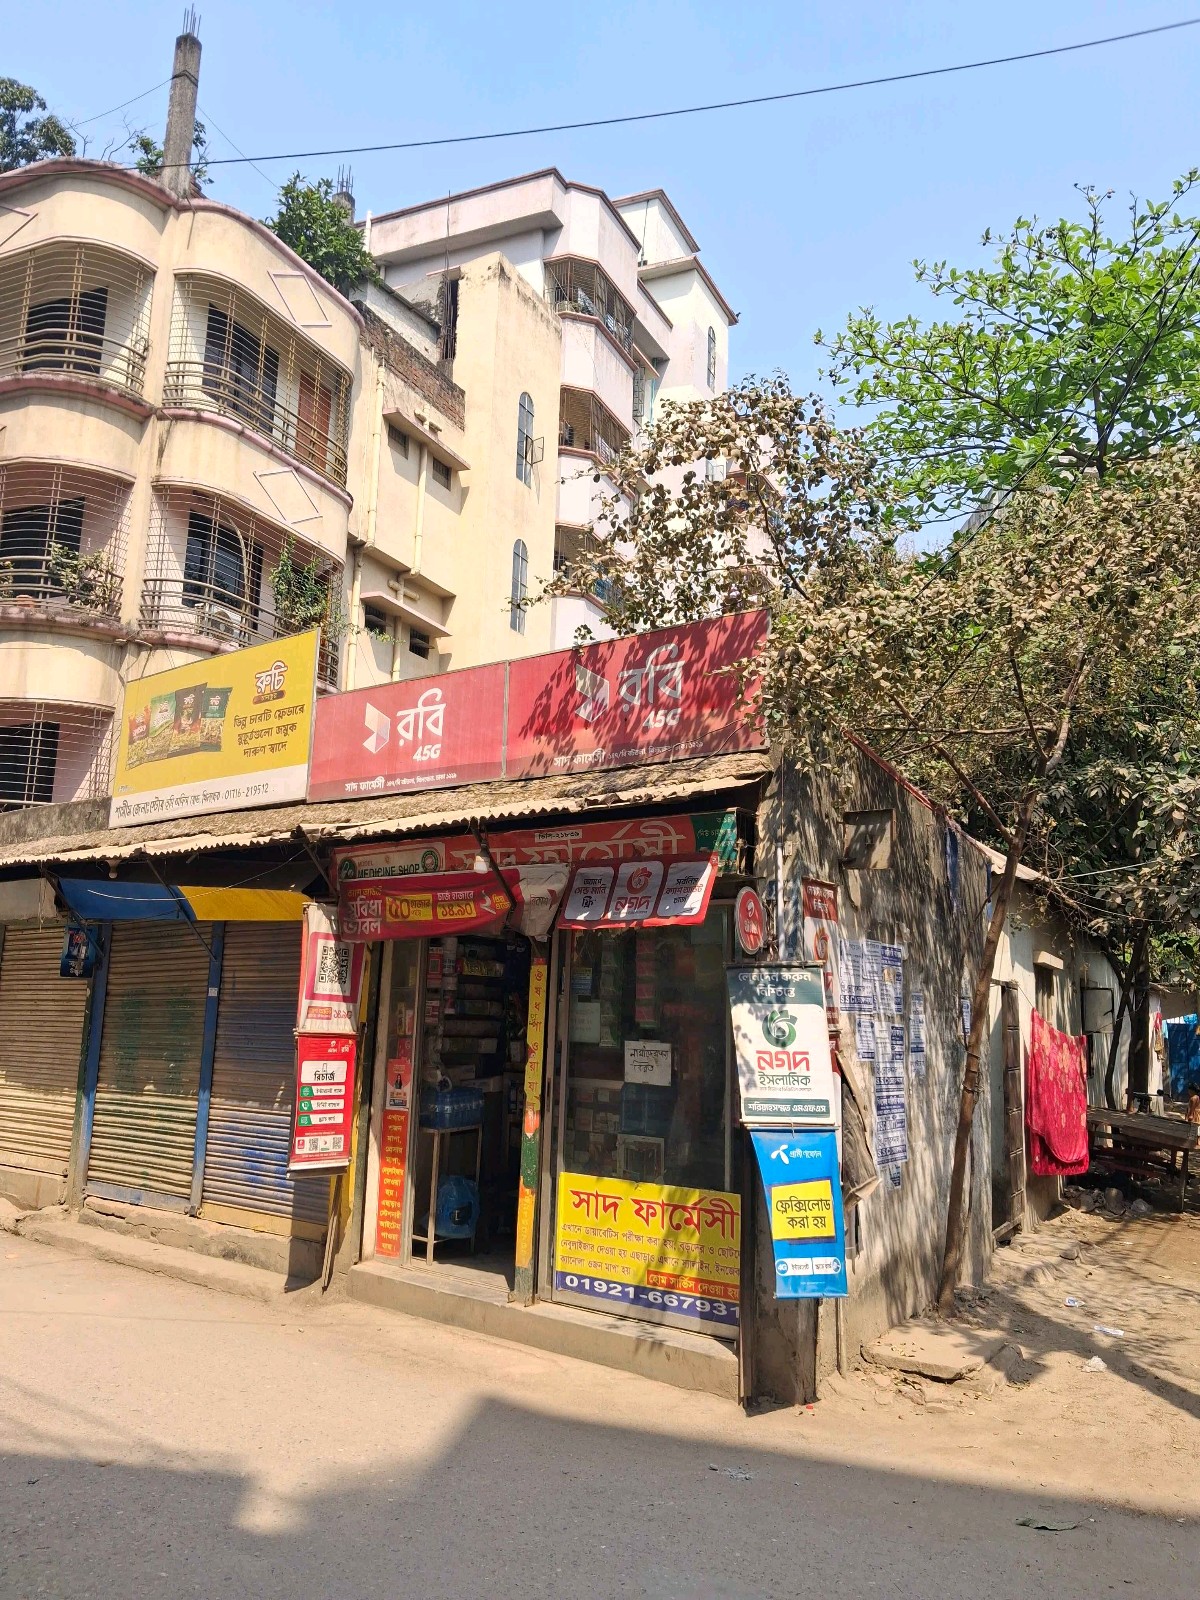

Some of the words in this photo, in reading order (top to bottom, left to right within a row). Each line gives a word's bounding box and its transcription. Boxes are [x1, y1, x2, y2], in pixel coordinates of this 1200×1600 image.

[255, 660, 288, 694] রুচি
[618, 643, 686, 712] রবি
[233, 715, 248, 730] ভিন্ন
[249, 709, 272, 725] চারটি
[397, 688, 446, 747] রবি
[276, 722, 298, 737] জমুক
[243, 745, 267, 758] দারুণ
[553, 756, 571, 767] সাদ
[344, 781, 358, 792] সাদ
[398, 864, 420, 875] SHOP
[452, 890, 474, 901] হাজারে
[386, 898, 411, 919] ৫০
[440, 902, 473, 917] ১৪.৯০
[614, 896, 652, 912] নগদ
[738, 971, 779, 983] লেনদেন
[780, 971, 812, 982] করুন
[755, 1050, 811, 1071] নগদ
[313, 1071, 336, 1081] রিচার্জ
[758, 1071, 811, 1086] ইসলামিক
[791, 1103, 827, 1113] এমএফএস
[775, 1195, 831, 1215] ফ্লেক্সিলোড
[569, 1190, 624, 1222] সাদ
[630, 1195, 740, 1240] ফার্মেসী
[786, 1215, 809, 1229] করা
[812, 1215, 827, 1229] হয়
[561, 1223, 582, 1234] এখানে
[584, 1227, 619, 1240] ডায়াবেটিস
[621, 1230, 644, 1244] পরীক্ষা
[647, 1236, 659, 1246] করা
[708, 1245, 715, 1255] ও
[560, 1239, 595, 1253] নেবুলাইজার
[596, 1244, 616, 1257] দেওয়া
[618, 1249, 627, 1259] হয়
[657, 1255, 679, 1267] এখানে
[588, 1260, 603, 1270] ওজন
[604, 1262, 619, 1273] মাপা
[621, 1266, 631, 1276] হয়
[648, 1273, 667, 1286] হোম
[669, 1275, 696, 1291] সার্ভিস
[698, 1282, 725, 1297] দেওয়া
[565, 1275, 740, 1319] 01921-667931
